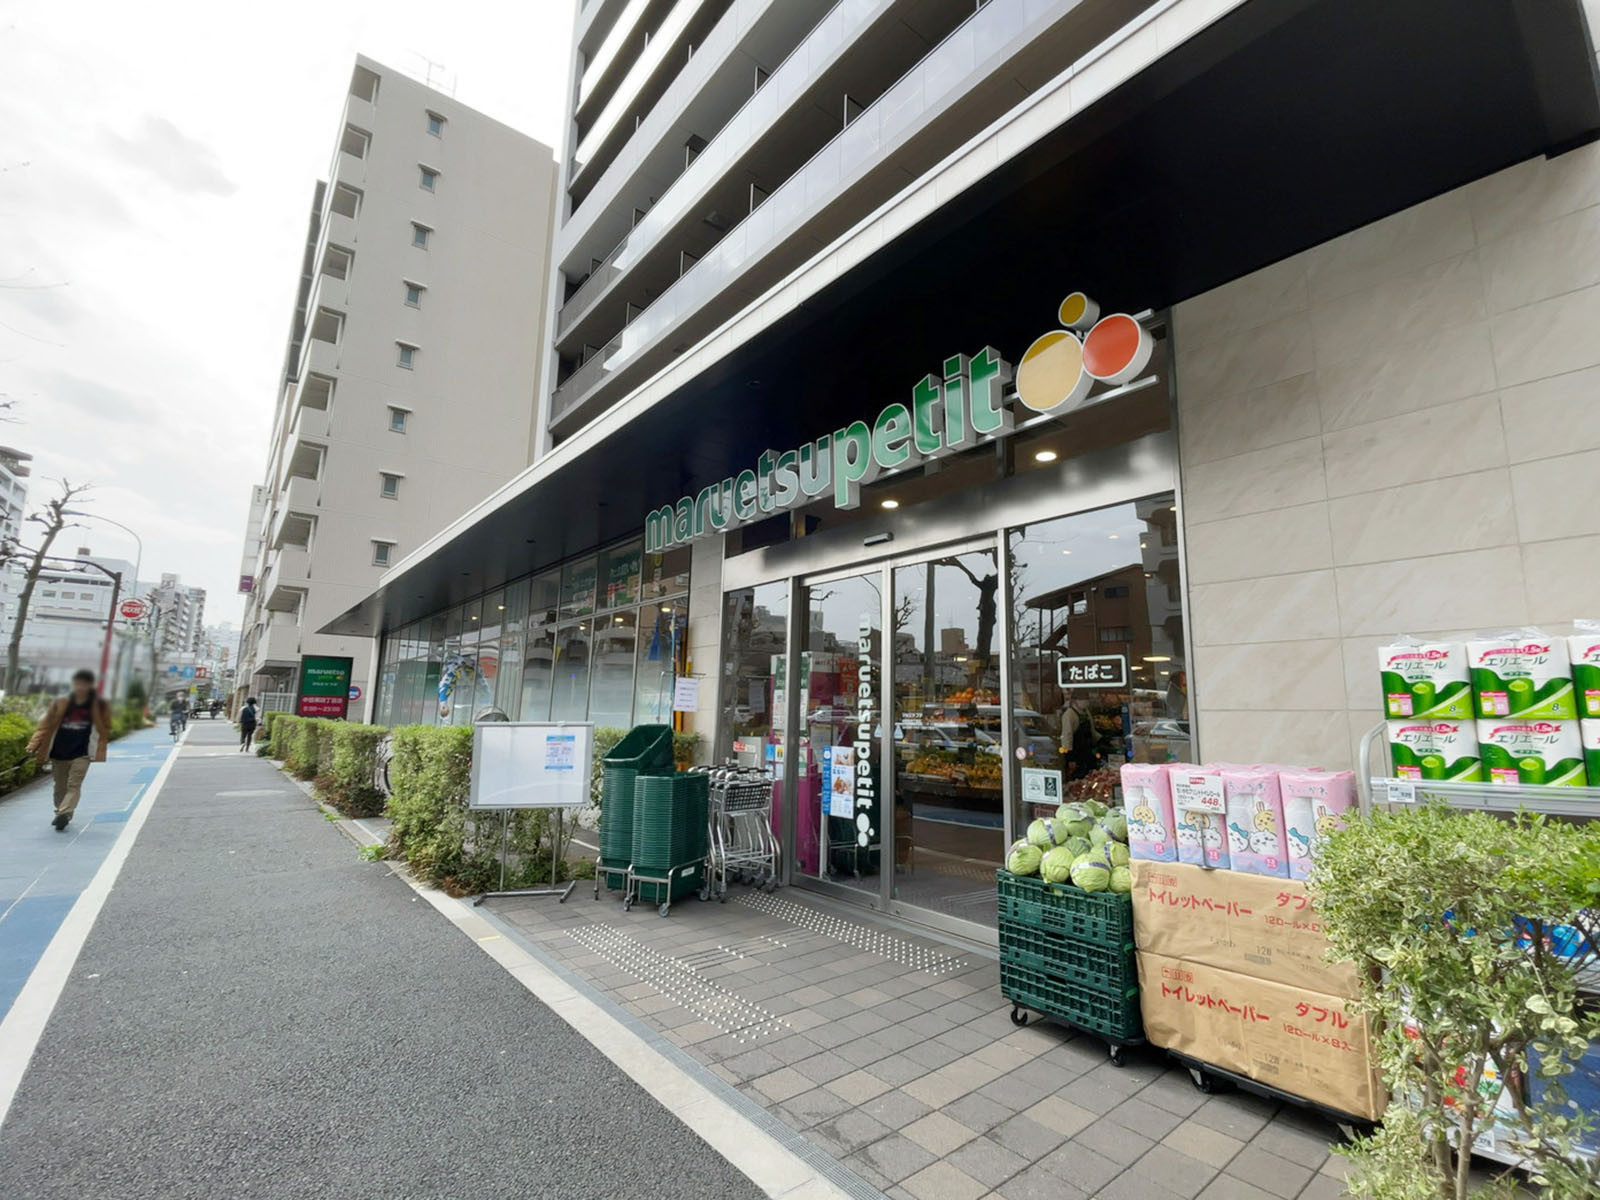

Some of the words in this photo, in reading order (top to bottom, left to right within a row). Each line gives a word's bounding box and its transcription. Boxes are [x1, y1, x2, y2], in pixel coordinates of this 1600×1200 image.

[645, 345, 1012, 554] maruetsupetit
[1391, 660, 1447, 672] エリエール
[1485, 655, 1549, 668] エリエール
[1069, 663, 1114, 680] たばこ
[854, 612, 875, 809] maruetsupetit
[1401, 734, 1457, 745] エリエール
[1495, 734, 1560, 746] エリエール
[1201, 797, 1219, 806] 448
[1149, 888, 1252, 917] トイレットペーパー
[1276, 892, 1315, 912] ダブ
[1161, 982, 1270, 1023] トイレットペーパー
[1295, 1001, 1349, 1029] ダブル
